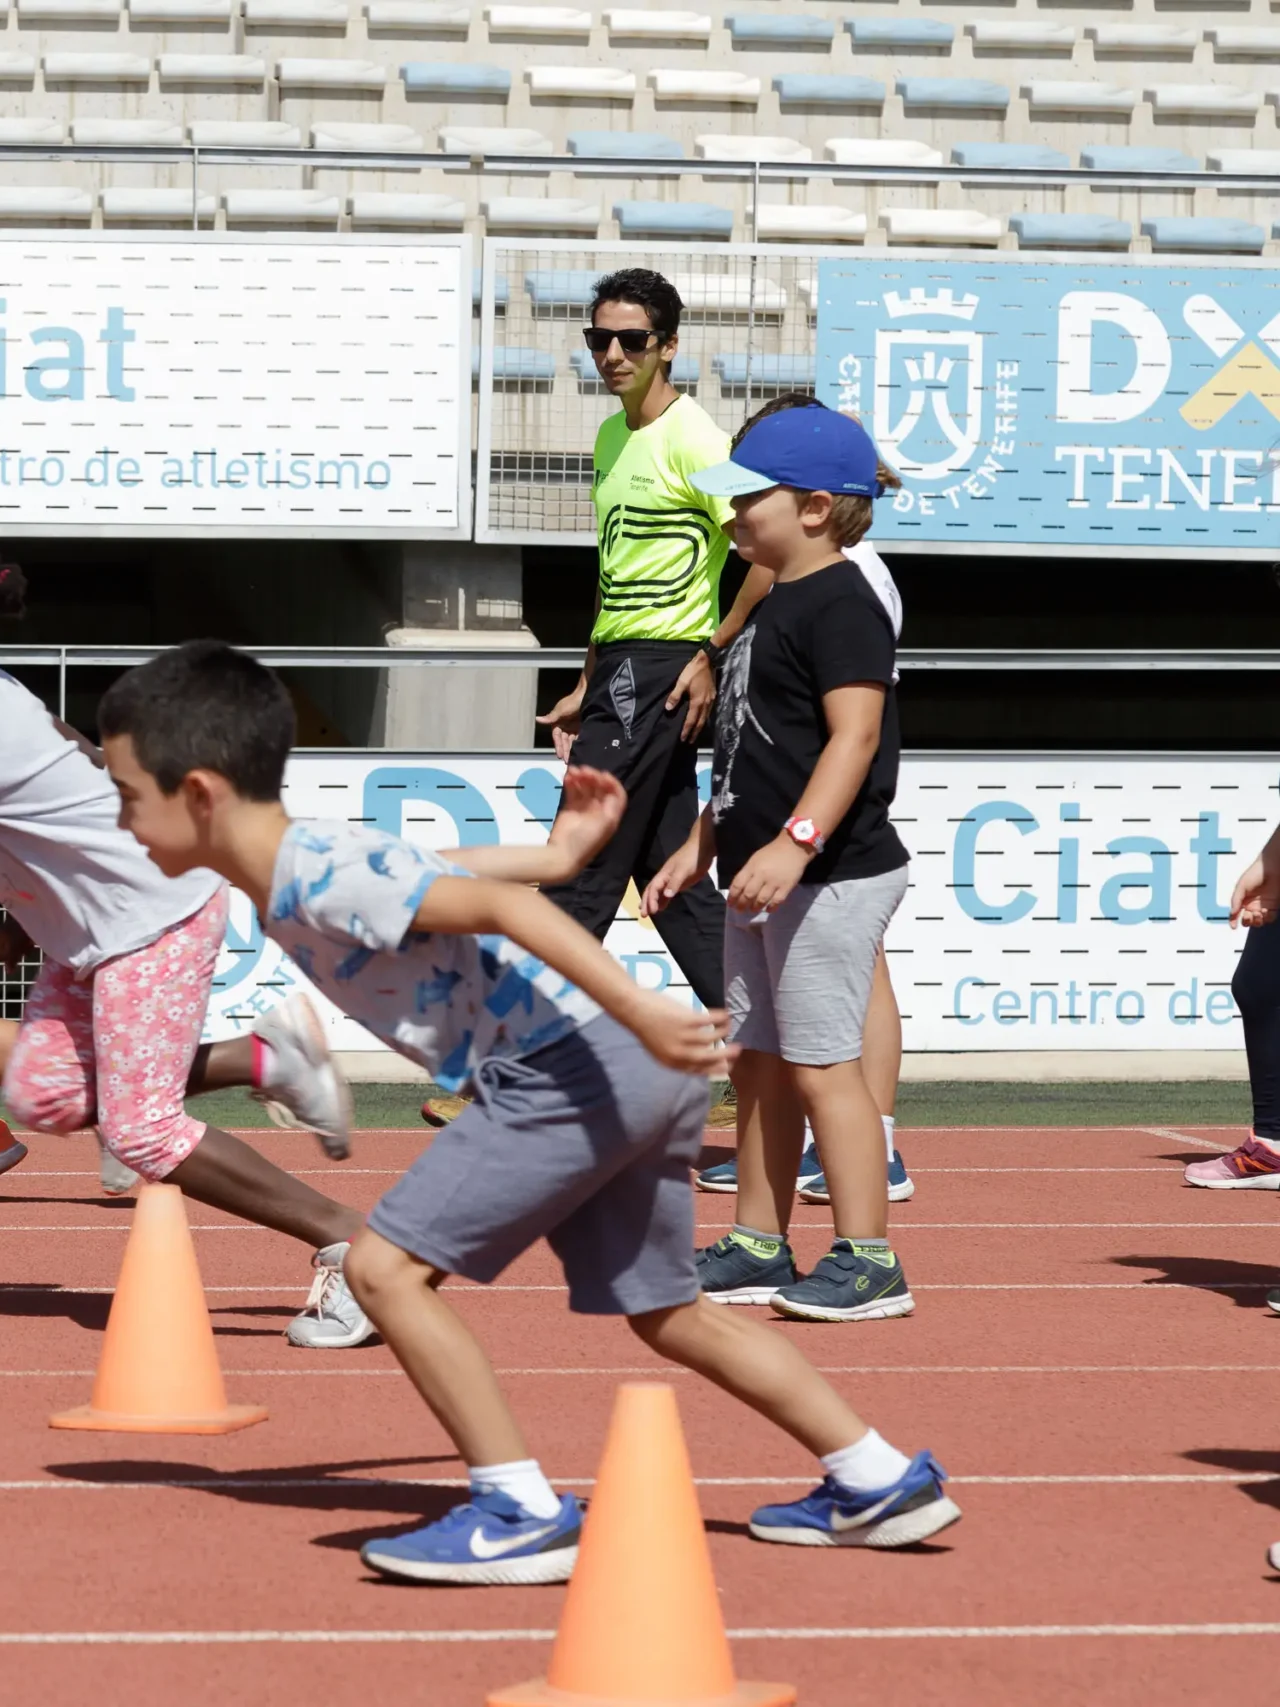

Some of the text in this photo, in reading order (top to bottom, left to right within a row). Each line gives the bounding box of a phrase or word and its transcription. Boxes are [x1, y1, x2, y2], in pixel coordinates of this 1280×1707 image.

[85, 446, 140, 487] de
[160, 448, 391, 491] atletismo
[942, 360, 1020, 510] TENERIFE
[1055, 446, 1280, 513] TENE
[953, 801, 1234, 925] Ciat
[953, 976, 1235, 1025] Centro de
